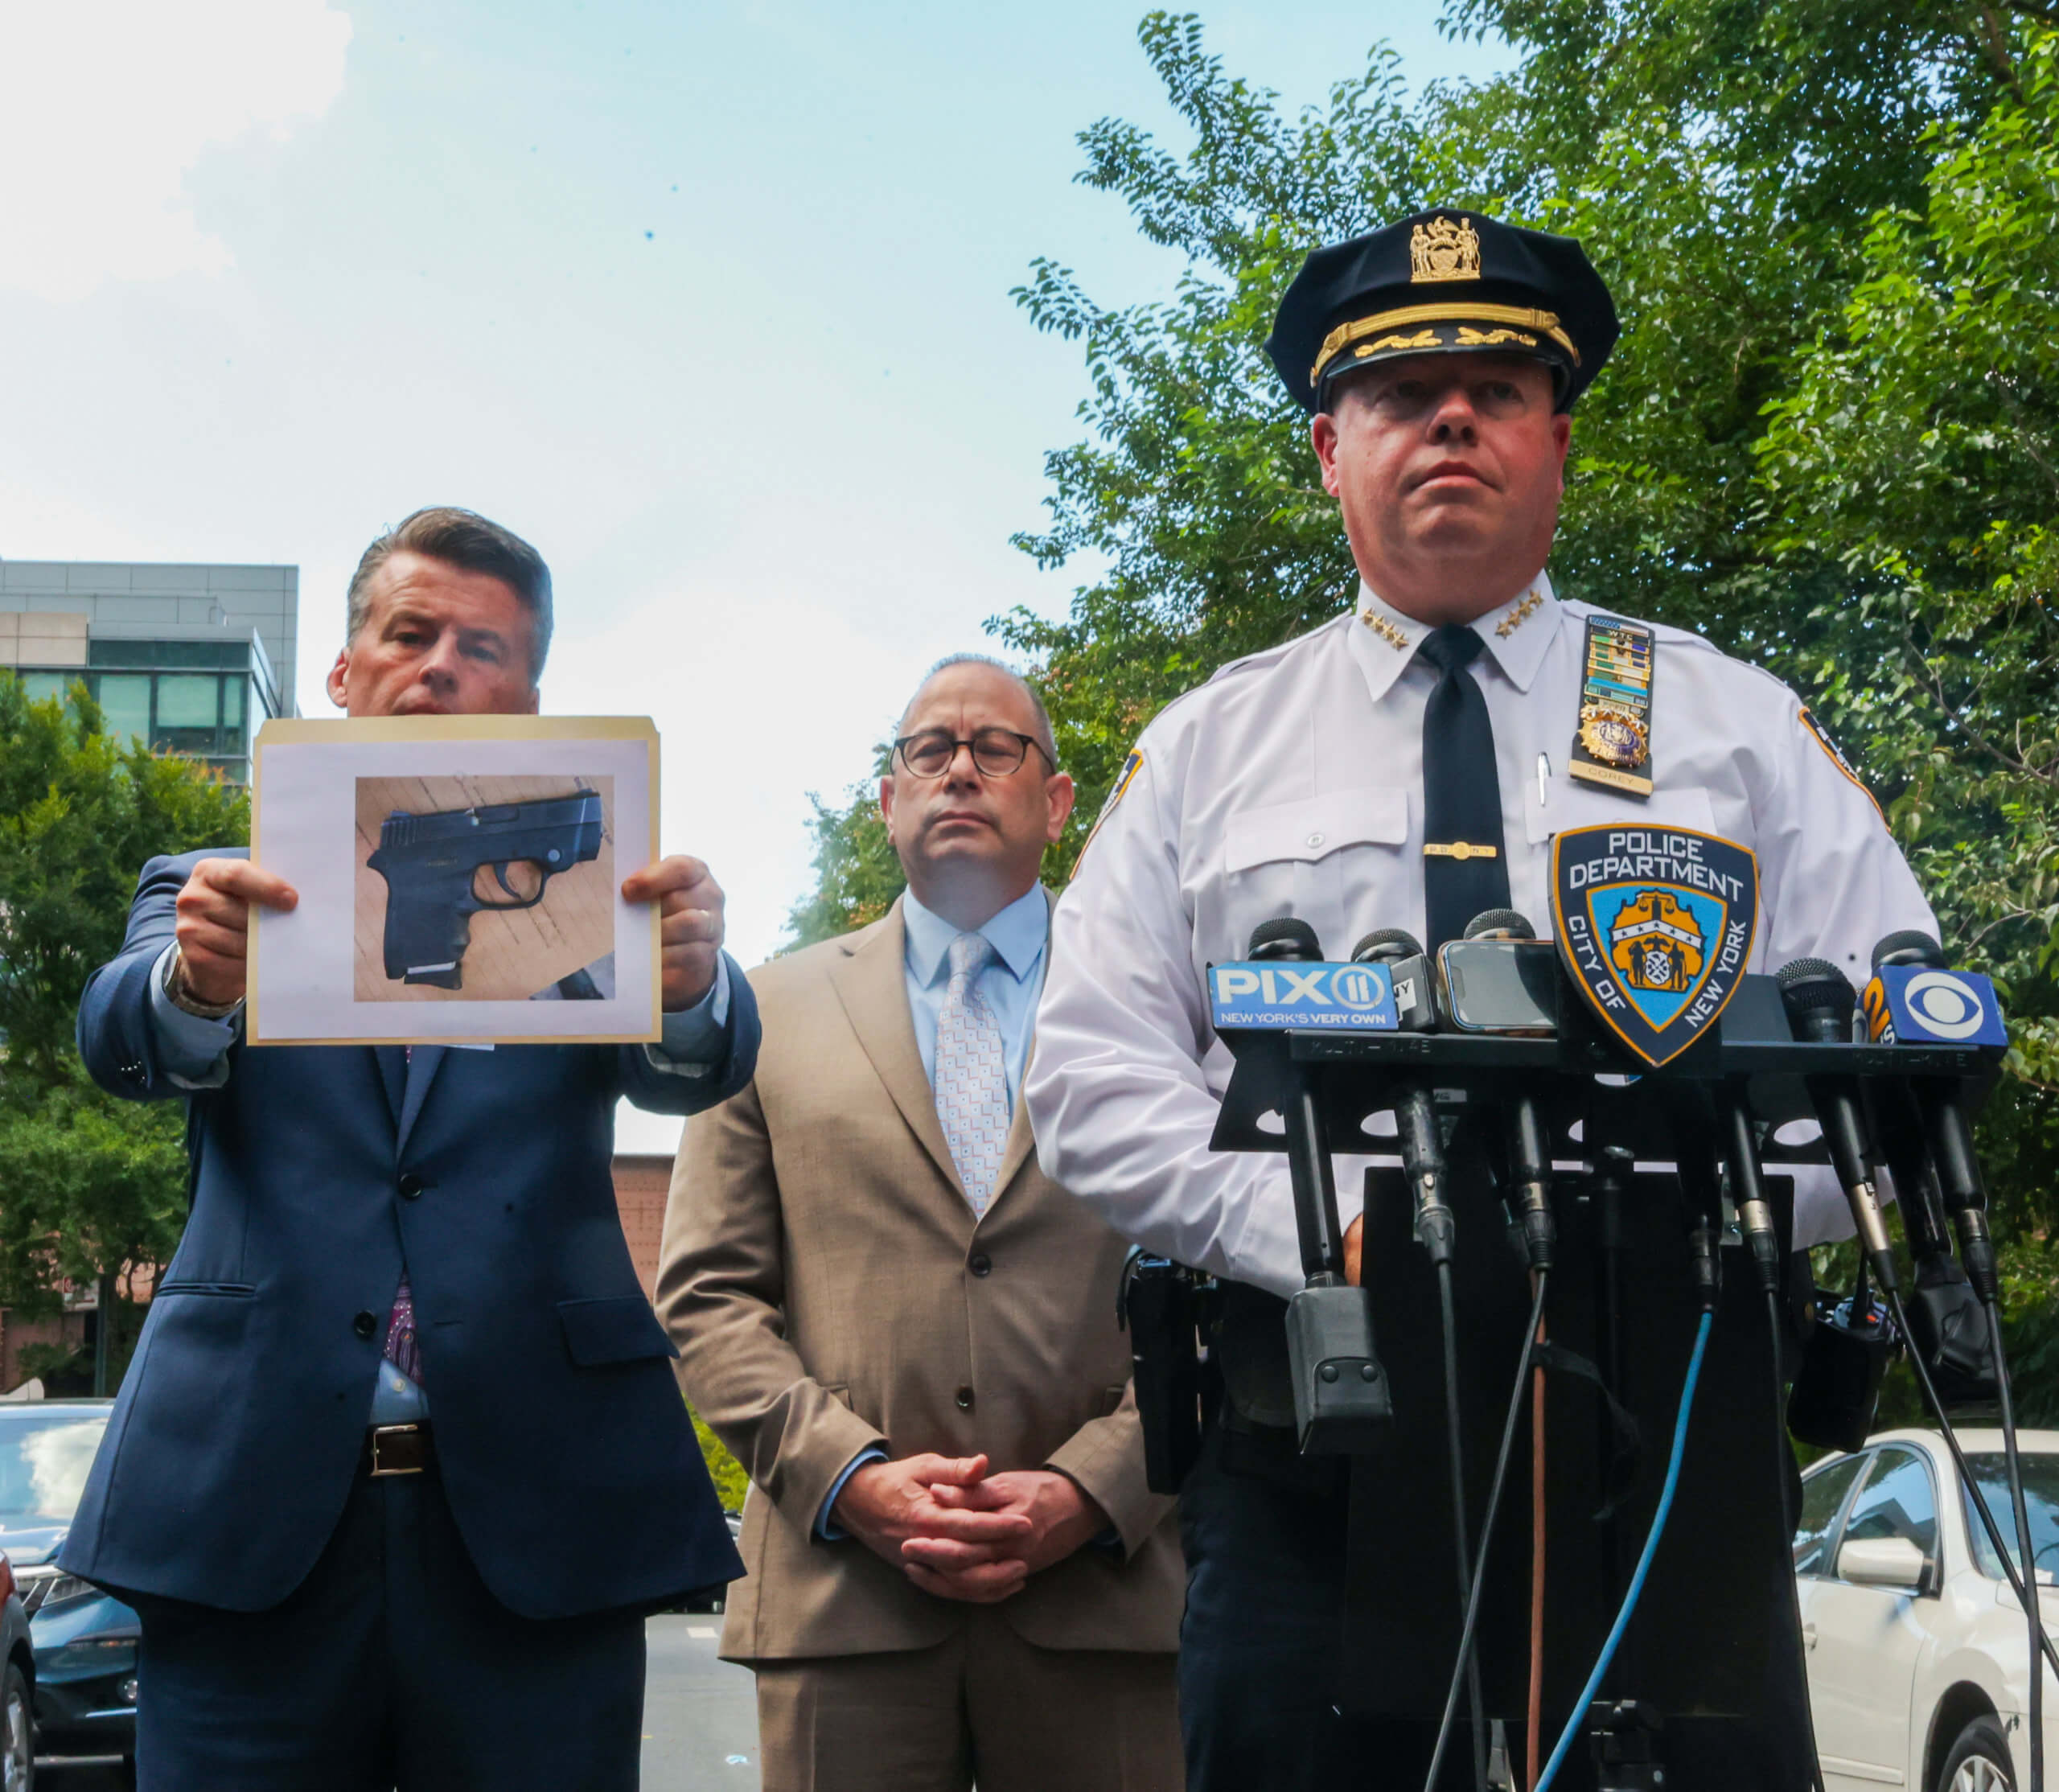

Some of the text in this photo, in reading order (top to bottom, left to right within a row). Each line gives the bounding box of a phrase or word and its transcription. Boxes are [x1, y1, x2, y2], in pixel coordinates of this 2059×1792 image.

[1609, 832, 1704, 862] POLICE
[1570, 855, 1744, 902] DEPARTMENT
[1568, 914, 1747, 1028] CITY OF NEW YORK
[1220, 1013, 1387, 1024] NEW YORK'S VERY OWN
